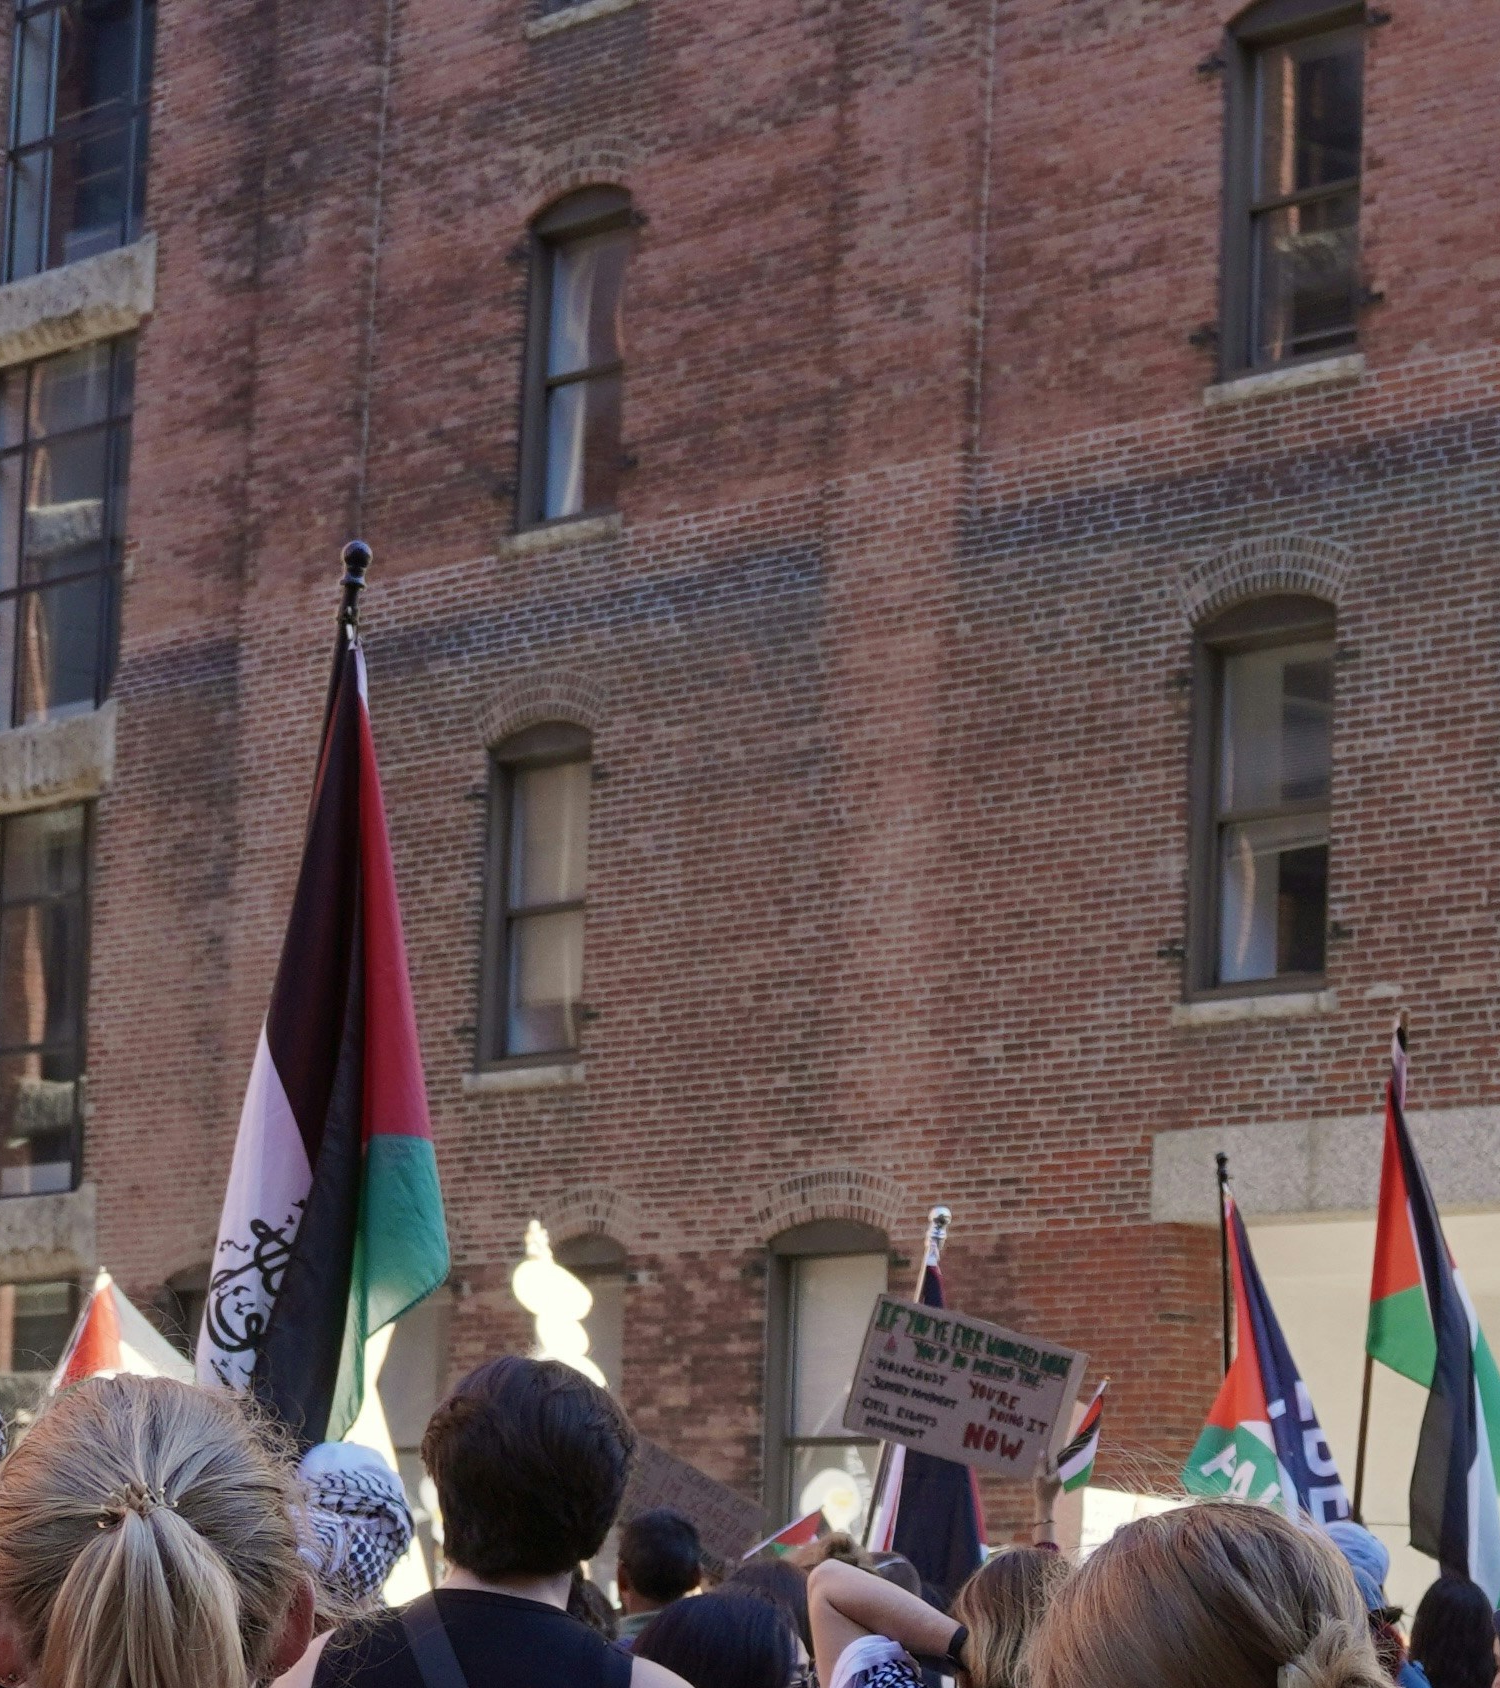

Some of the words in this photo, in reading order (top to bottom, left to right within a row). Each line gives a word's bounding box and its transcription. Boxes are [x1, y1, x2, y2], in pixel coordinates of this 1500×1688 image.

[968, 1378, 1021, 1411] YOU'RE
[961, 1421, 1026, 1462] NOW
[1025, 1416, 1049, 1436] IT
